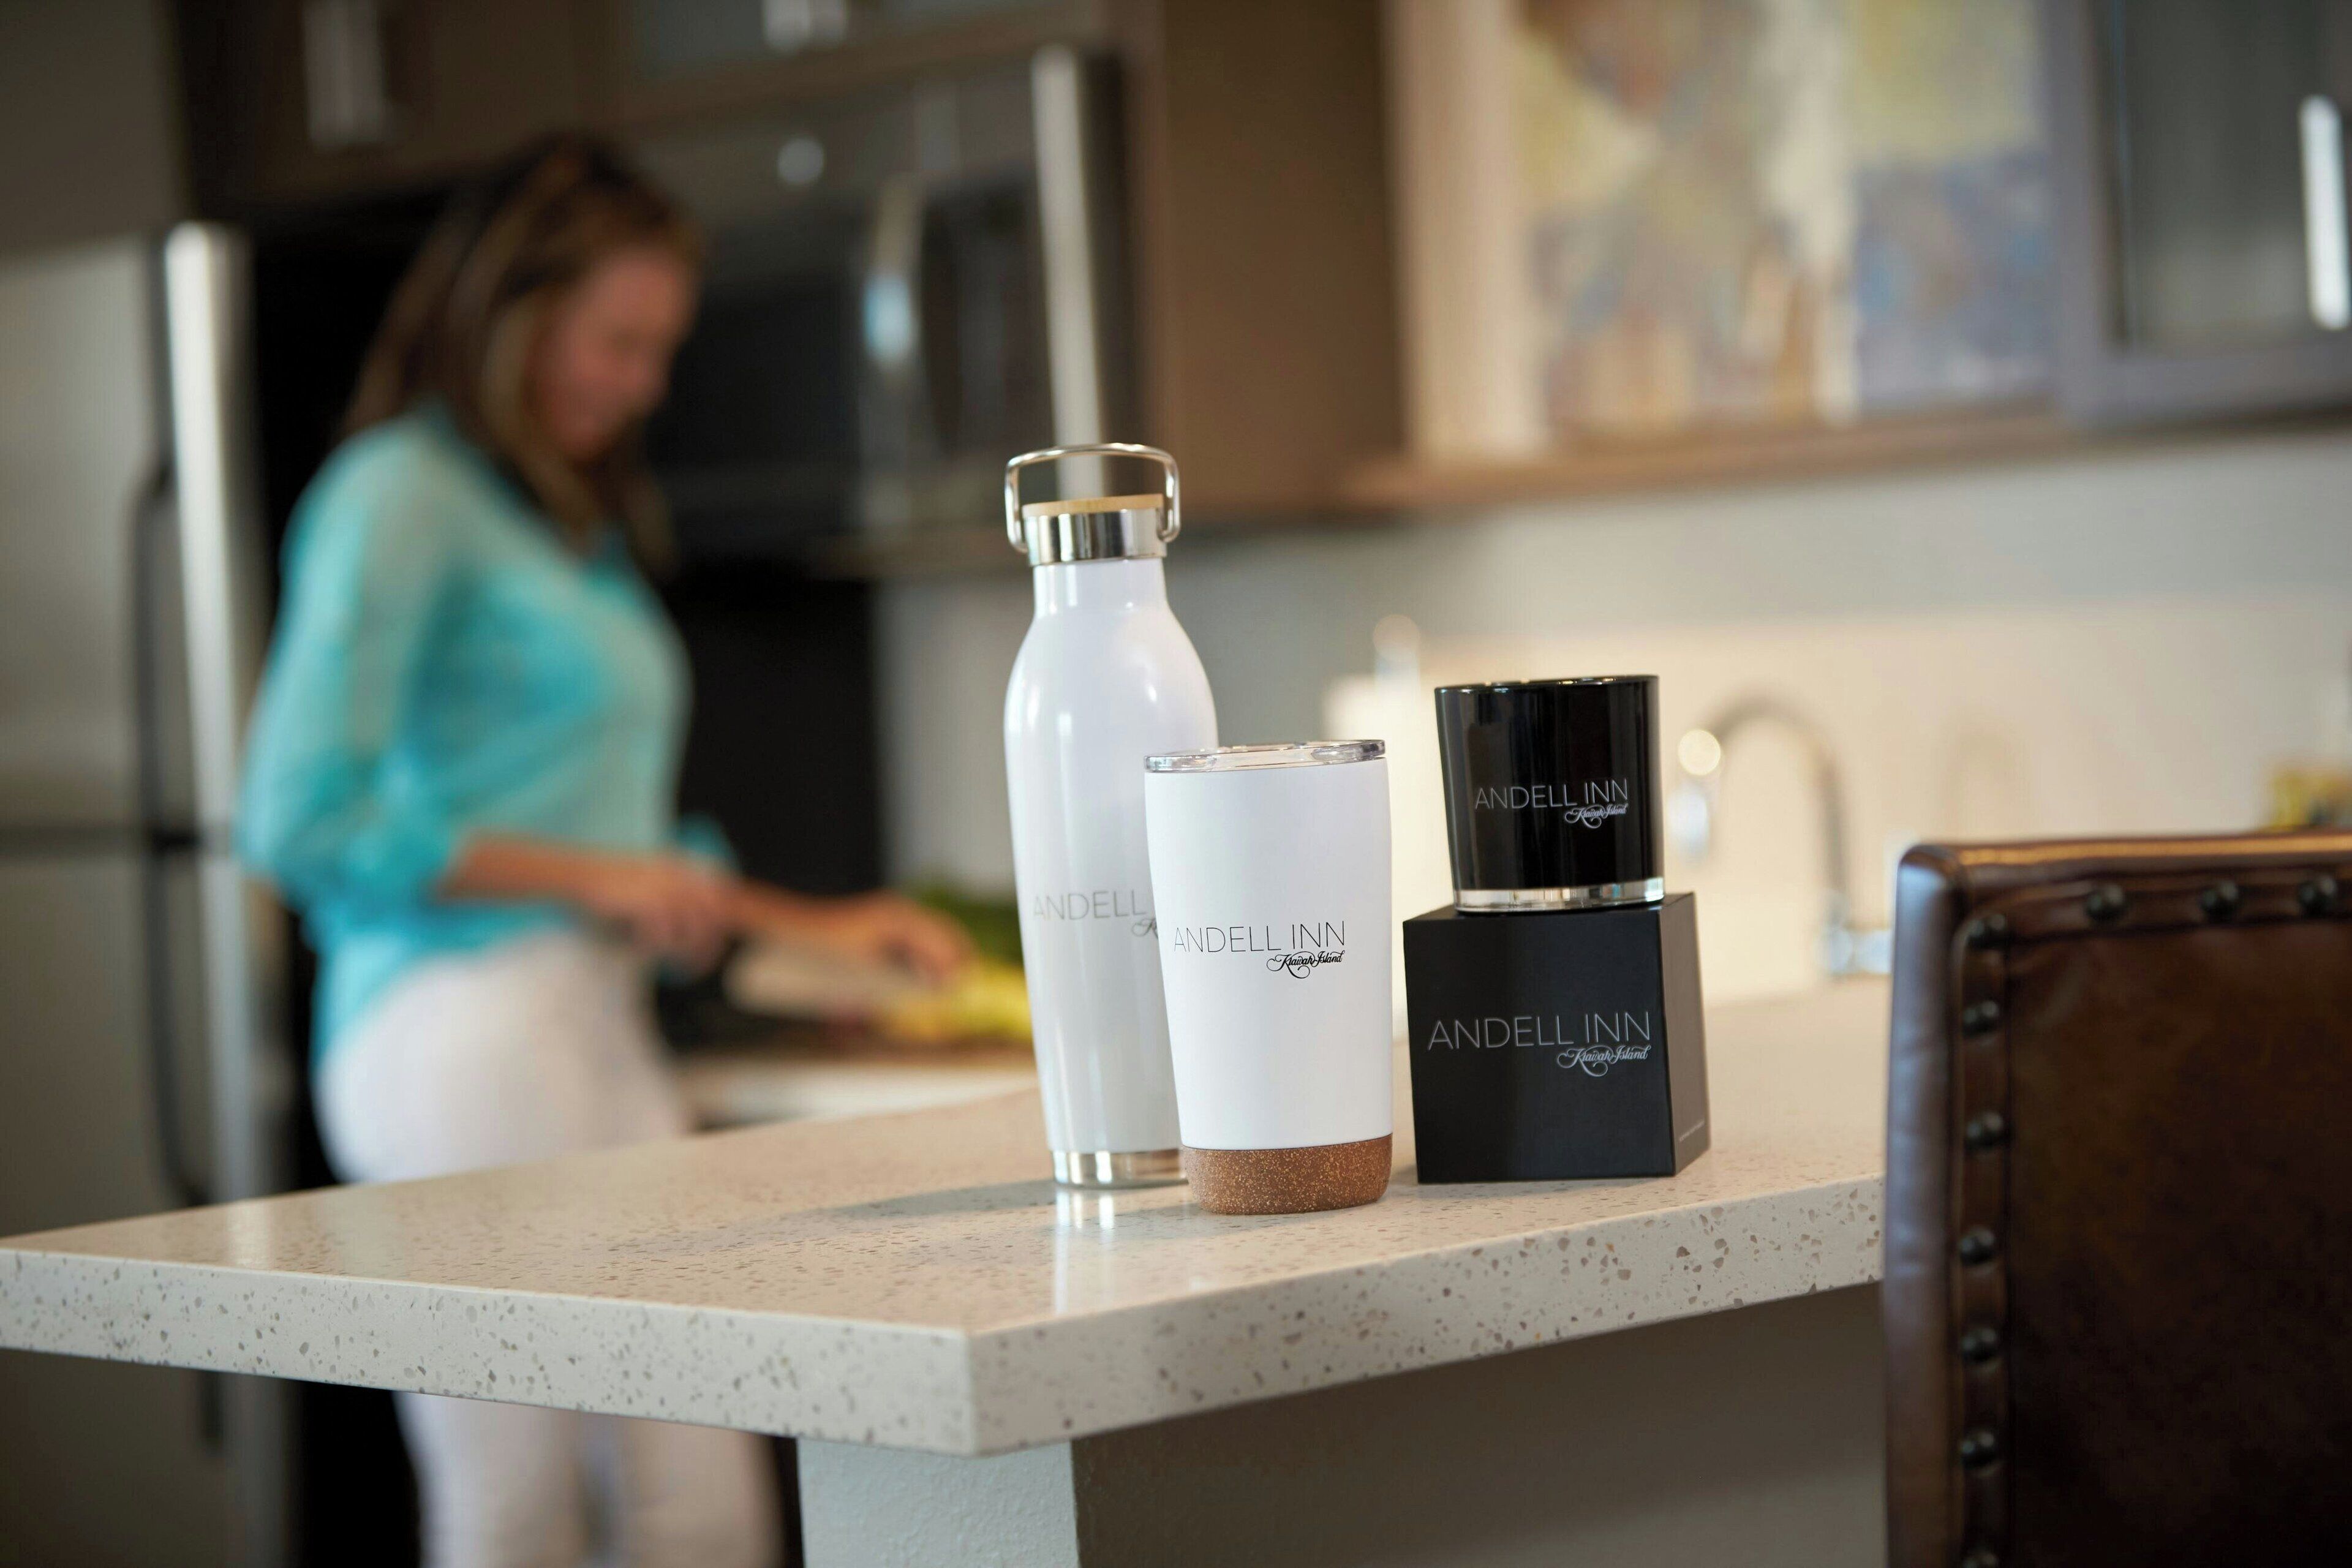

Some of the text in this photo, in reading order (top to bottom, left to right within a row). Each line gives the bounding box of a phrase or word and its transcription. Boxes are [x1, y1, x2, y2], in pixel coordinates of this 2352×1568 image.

[1474, 778, 1628, 810] ANDELL INN
[1602, 803, 1629, 819] Island
[1033, 890, 1147, 920] ANDELL
[1174, 925, 1281, 953] ANDELL
[1291, 921, 1345, 949] INN
[1267, 950, 1345, 979] Kiawah Island
[1427, 1011, 1650, 1051] ANDELL INN
[1557, 1044, 1652, 1077] Kiawah Island
